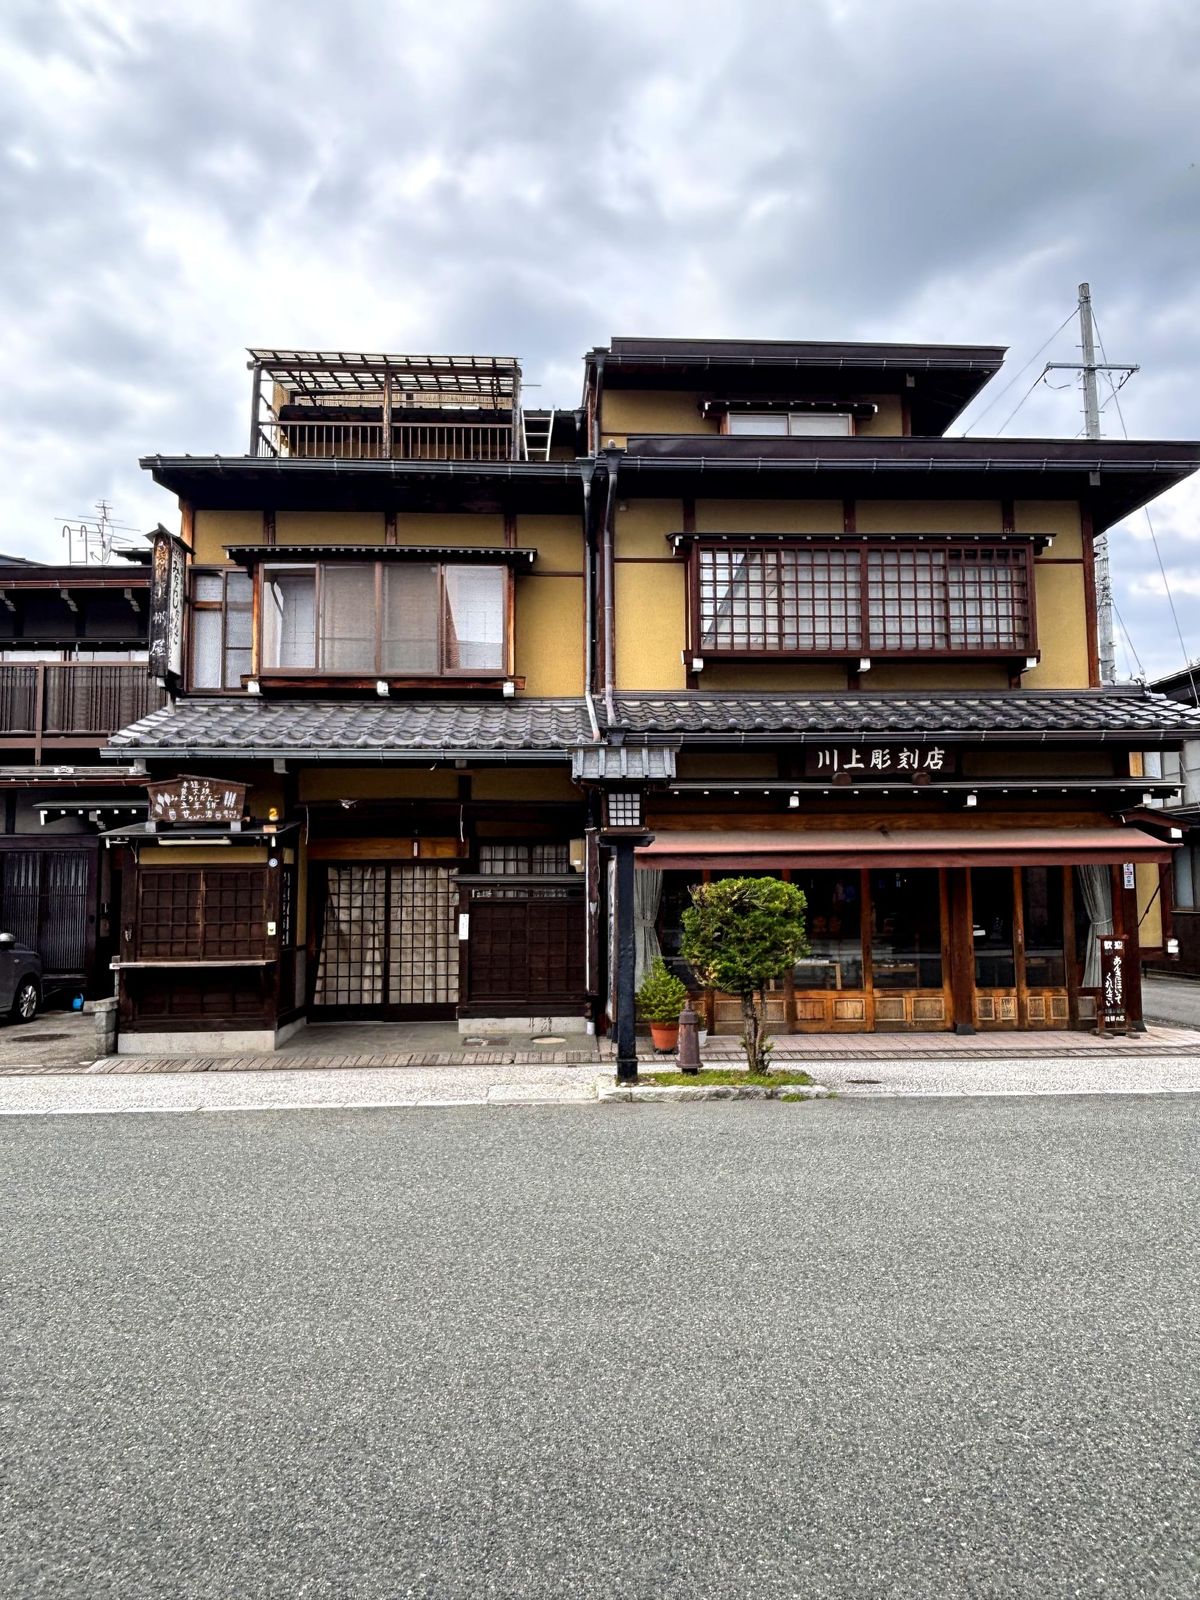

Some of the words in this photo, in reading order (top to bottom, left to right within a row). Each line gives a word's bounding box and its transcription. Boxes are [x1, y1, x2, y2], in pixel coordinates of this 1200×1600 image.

[817, 746, 945, 772] 川上彫刻店
[170, 795, 221, 803] みたらしだんご
